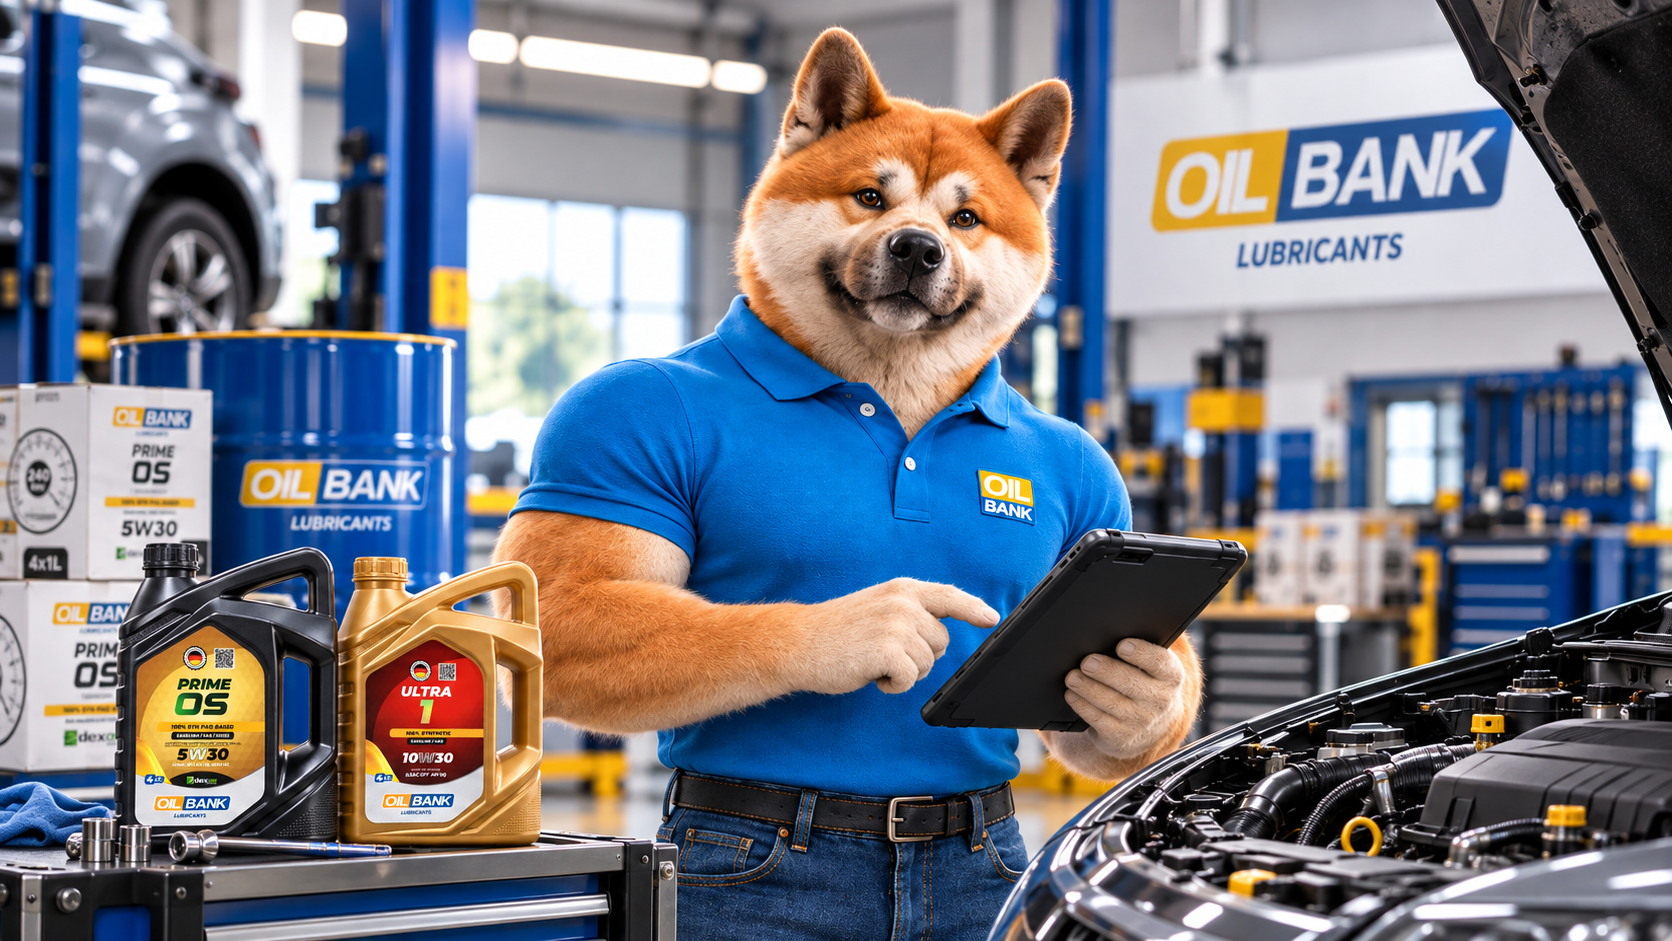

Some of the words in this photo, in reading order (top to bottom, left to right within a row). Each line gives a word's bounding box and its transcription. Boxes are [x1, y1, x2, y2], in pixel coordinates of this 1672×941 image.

[1165, 148, 1269, 219] OIL
[1291, 127, 1497, 209] BANK
[1236, 233, 1404, 269] LUBRICANTS
[145, 409, 190, 427] BANK
[132, 444, 175, 458] PRIME
[28, 468, 50, 482] 240
[131, 460, 171, 484] OS
[250, 468, 311, 500] OIL
[323, 469, 424, 501] BANK
[984, 475, 1030, 503] OIL
[985, 499, 1032, 521] BANK
[121, 520, 177, 537] 5W30
[290, 515, 392, 531] LUBRICANTS
[28, 555, 63, 572] 4x1L
[56, 605, 86, 622] OIL
[90, 605, 129, 622] BAN
[74, 642, 119, 658] PRIM
[74, 661, 118, 688] OS
[177, 678, 232, 690] PRIME
[401, 686, 452, 697] ULTRA
[175, 692, 230, 715] OS
[420, 699, 434, 724] 1
[79, 730, 116, 743] dexo
[177, 748, 229, 761] 5W30
[402, 752, 454, 763] 10W30
[146, 775, 154, 783] 4
[375, 774, 384, 782] 4
[157, 798, 181, 809] OIL
[185, 798, 227, 809] BANK
[385, 796, 408, 807] OIL
[412, 796, 452, 806] BANK
